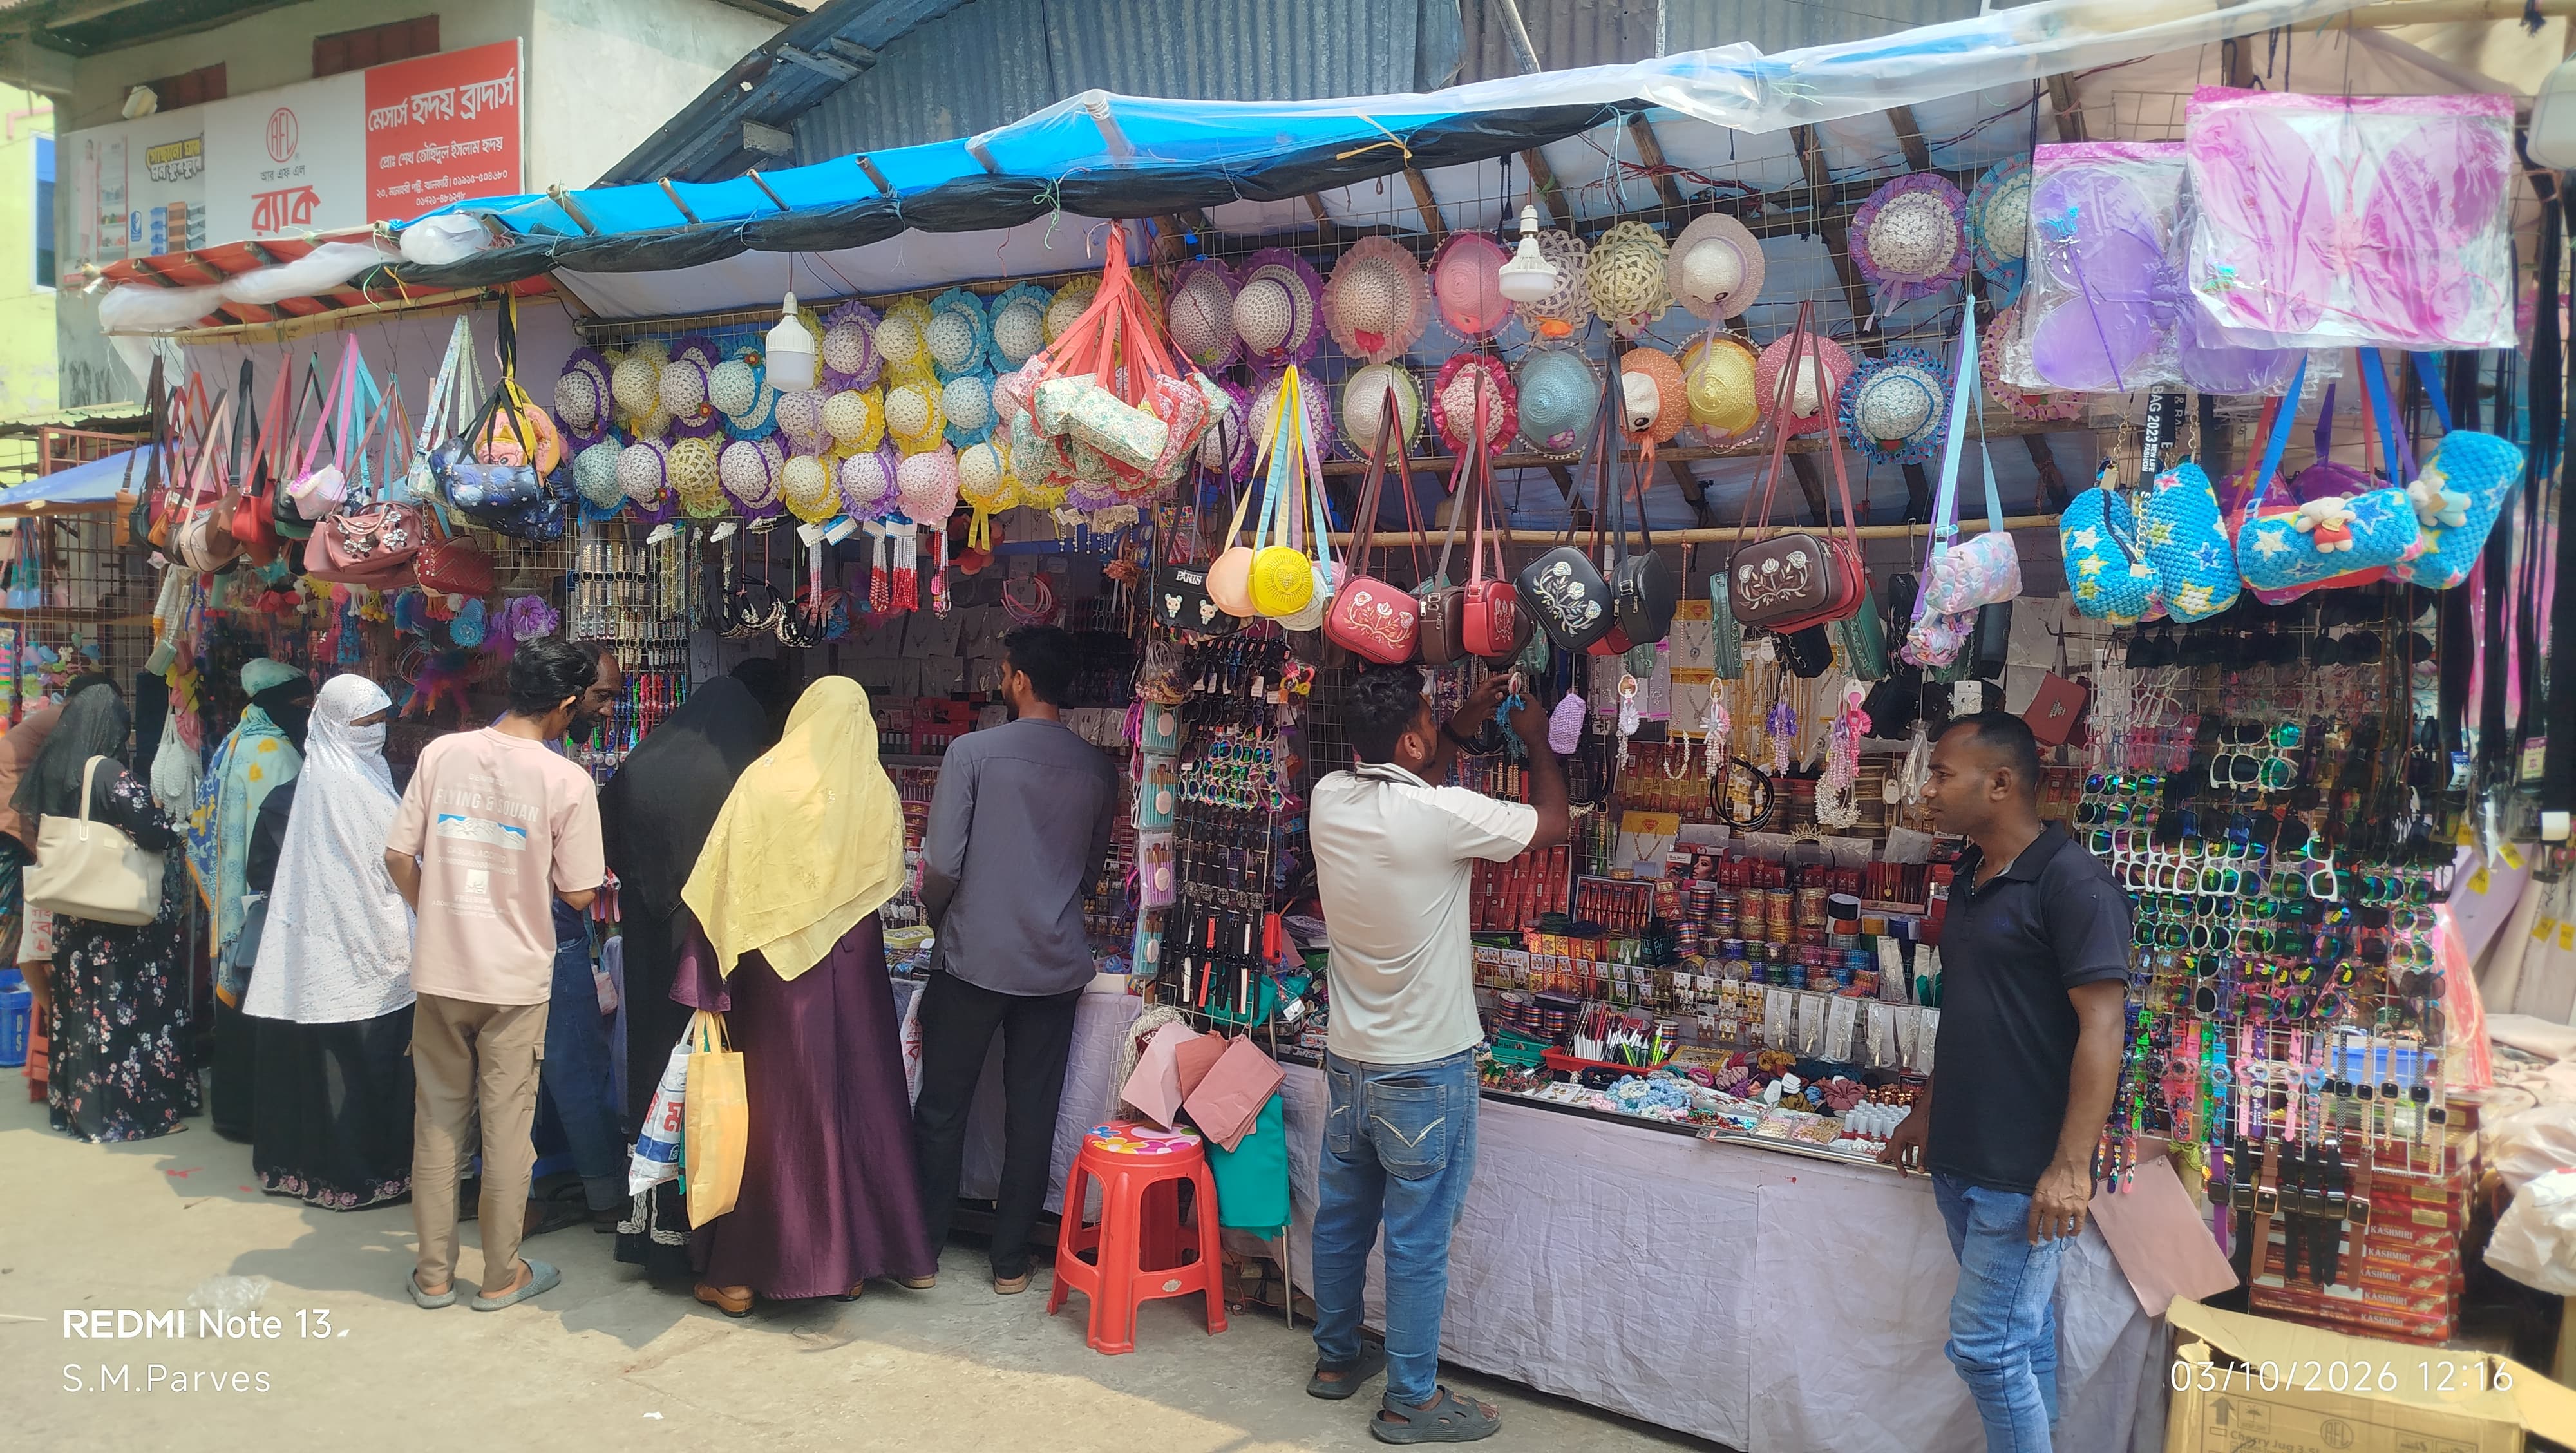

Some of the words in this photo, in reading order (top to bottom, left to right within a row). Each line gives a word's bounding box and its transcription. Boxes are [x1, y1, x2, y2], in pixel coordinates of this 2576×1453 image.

[368, 98, 408, 131] মেসার্স
[411, 88, 456, 124] হৃদয়
[459, 67, 515, 120] ব্রাদার্স
[398, 151, 414, 166] শেখ
[416, 141, 449, 164] তৌহিদুল
[451, 140, 480, 158] ইসলাম
[482, 136, 503, 154] হৃদয়
[260, 170, 274, 182] আর
[277, 166, 290, 179] এফ
[293, 164, 306, 176] এল
[2148, 385, 2164, 412] BAG
[2145, 415, 2161, 443] 2023
[2141, 442, 2151, 473] FASHION
[2148, 458, 2157, 473] LIFE
[1175, 569, 1203, 586] PARIS
[434, 788, 482, 810] FLYING
[486, 796, 495, 812] &
[2370, 1225, 2413, 1239] KASHMIRI
[2368, 1248, 2411, 1262] KASHMIRI
[2364, 1291, 2407, 1306] KASHMIRI
[2360, 1313, 2403, 1328] KASHMIRI
[2230, 1430, 2271, 1448] Cherry
